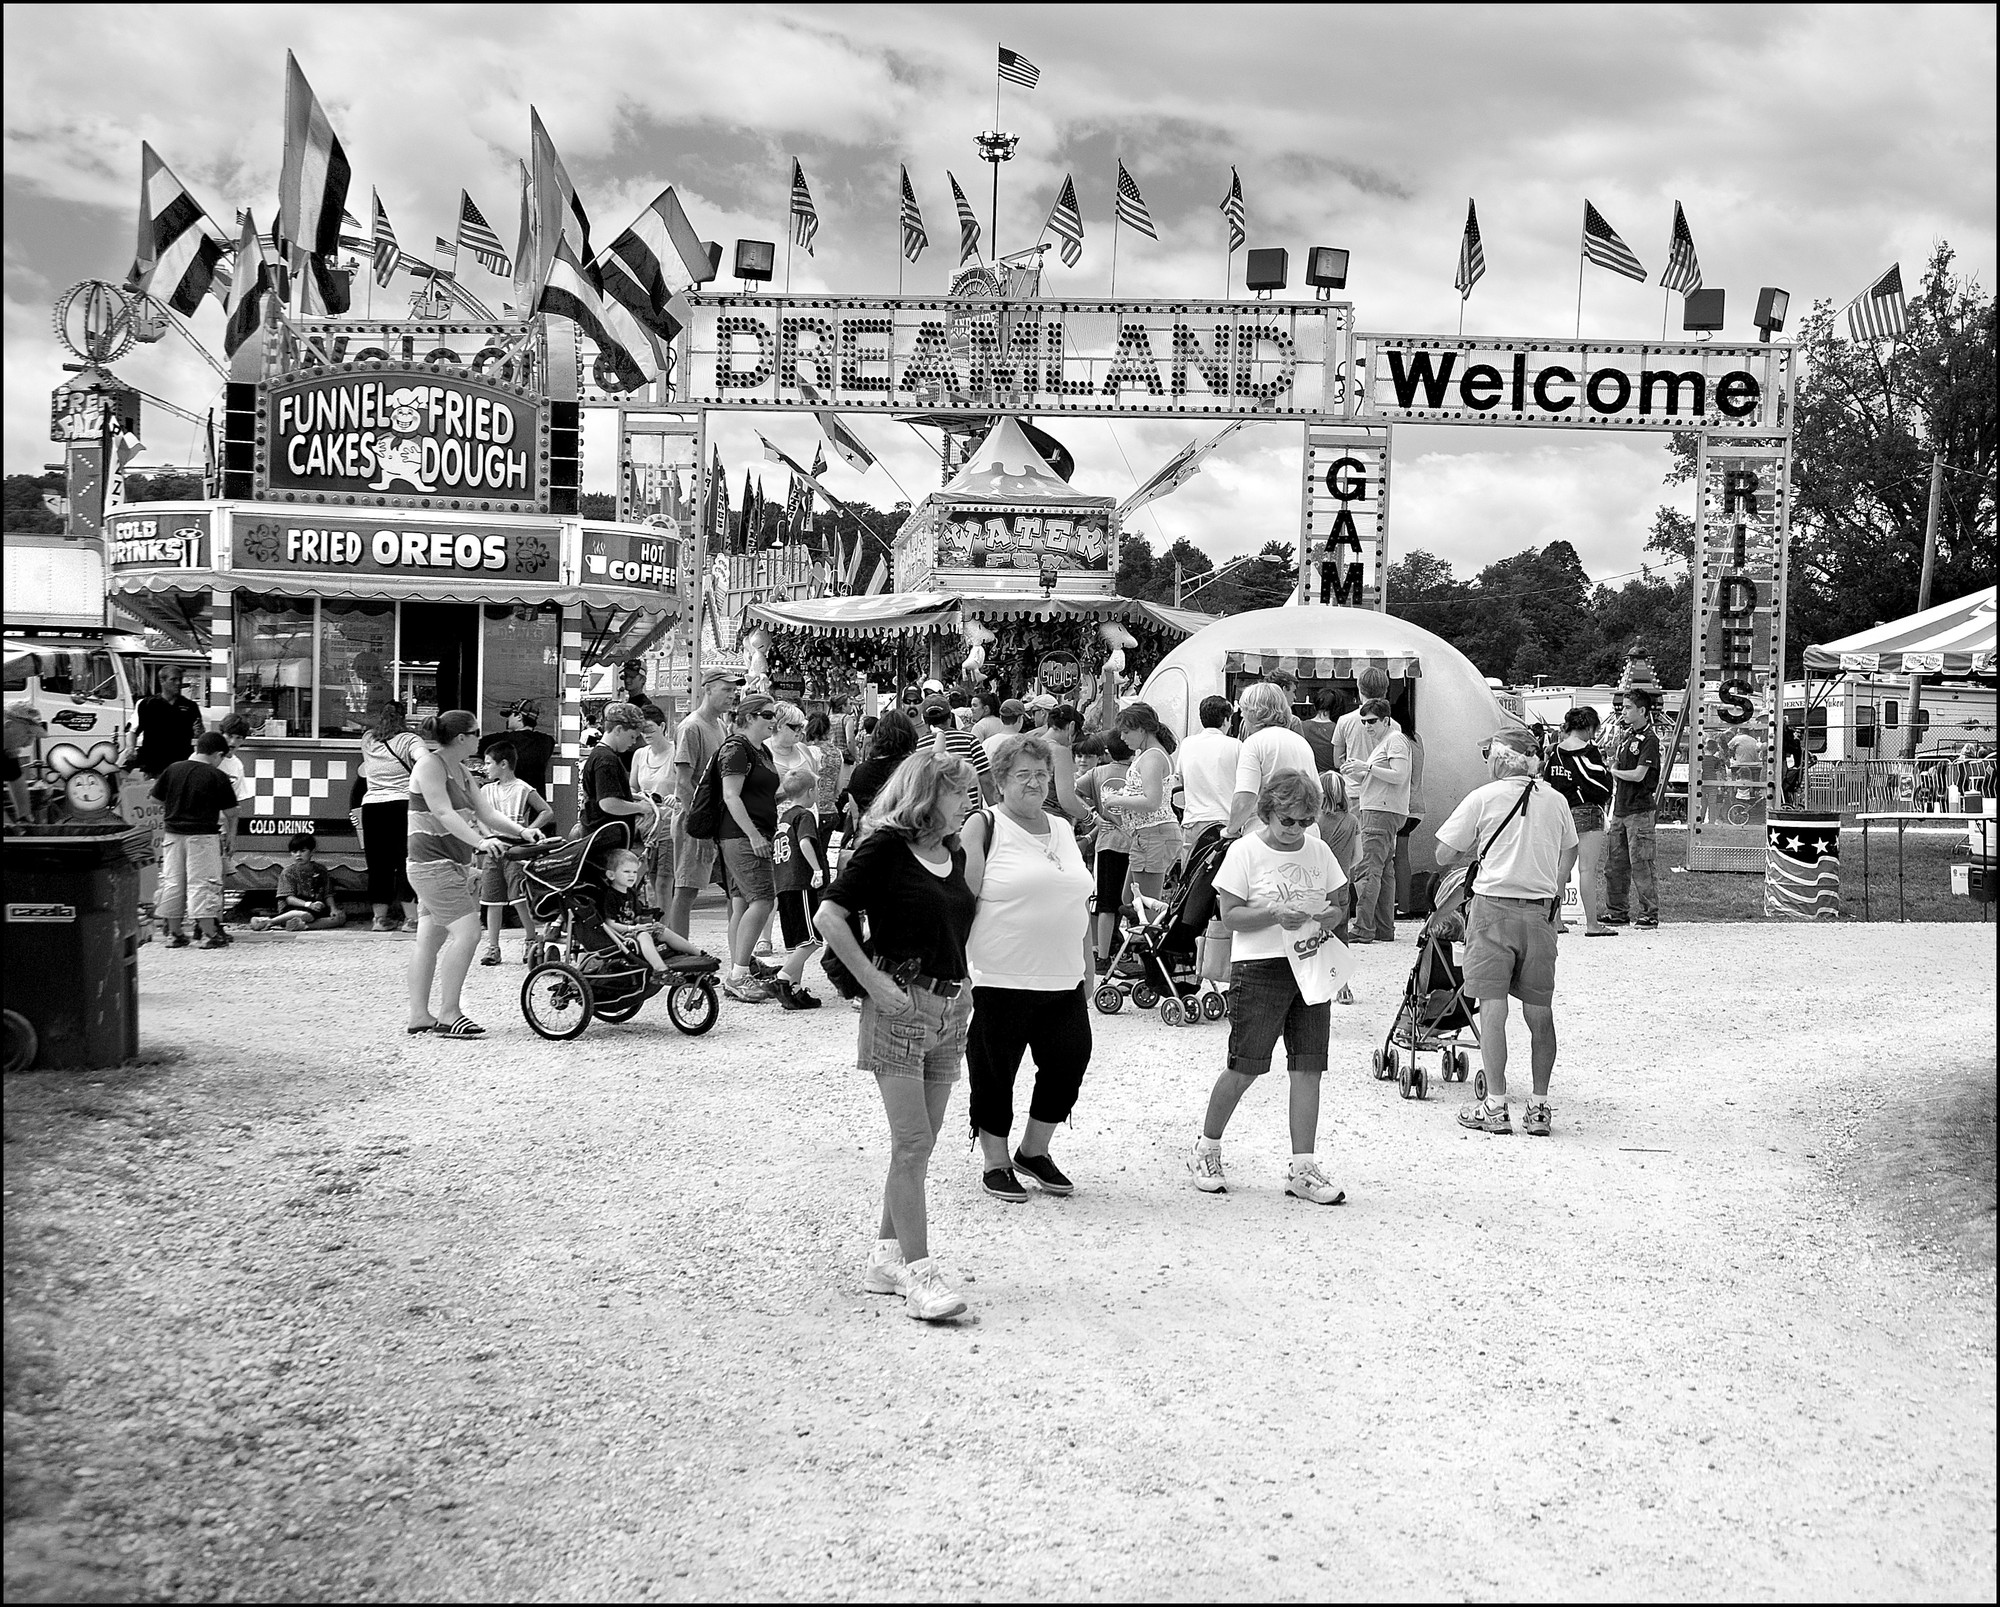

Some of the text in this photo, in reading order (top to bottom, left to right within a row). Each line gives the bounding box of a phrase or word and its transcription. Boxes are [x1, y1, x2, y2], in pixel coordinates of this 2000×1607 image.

[715, 315, 1298, 399] DREAMLAND
[1386, 350, 1761, 417] Welcome
[279, 380, 515, 445] FUNNEL FRIED
[287, 431, 528, 490] CAKES DOUGH
[108, 537, 183, 565] DRINKS
[116, 520, 158, 540] COLD
[286, 528, 507, 570] FRIED OREOS
[942, 515, 1104, 563] WATER
[608, 559, 677, 588] COFFEE
[640, 542, 665, 564] HOT
[985, 552, 1064, 570] FUN
[1717, 470, 1760, 725] RIDES
[249, 819, 315, 835] COLD DRINKS
